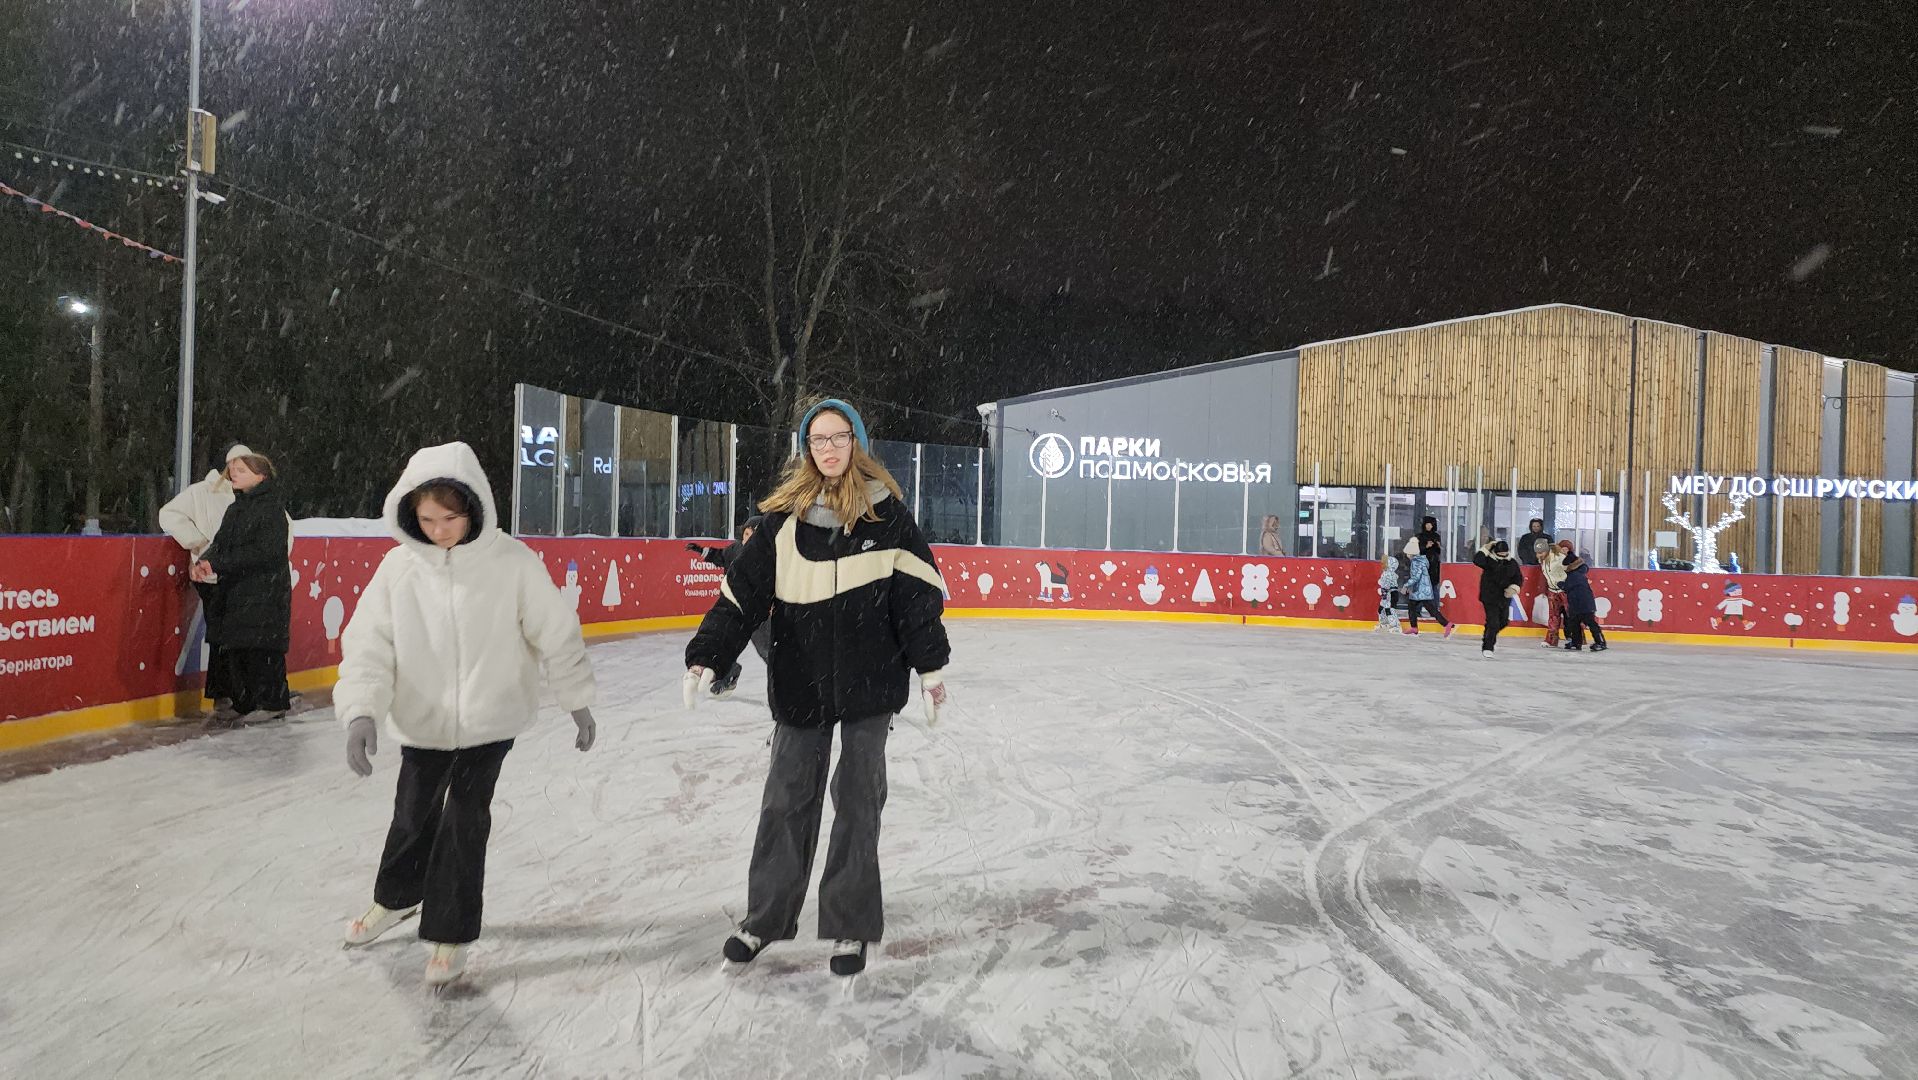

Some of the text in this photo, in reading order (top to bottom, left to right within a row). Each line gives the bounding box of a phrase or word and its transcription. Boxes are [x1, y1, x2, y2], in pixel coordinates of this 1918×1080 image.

[1080, 436, 1161, 458] ПАРКИ
[1079, 459, 1271, 484] ПОДМОСКОВЬЯ
[1729, 476, 1767, 498] ДО
